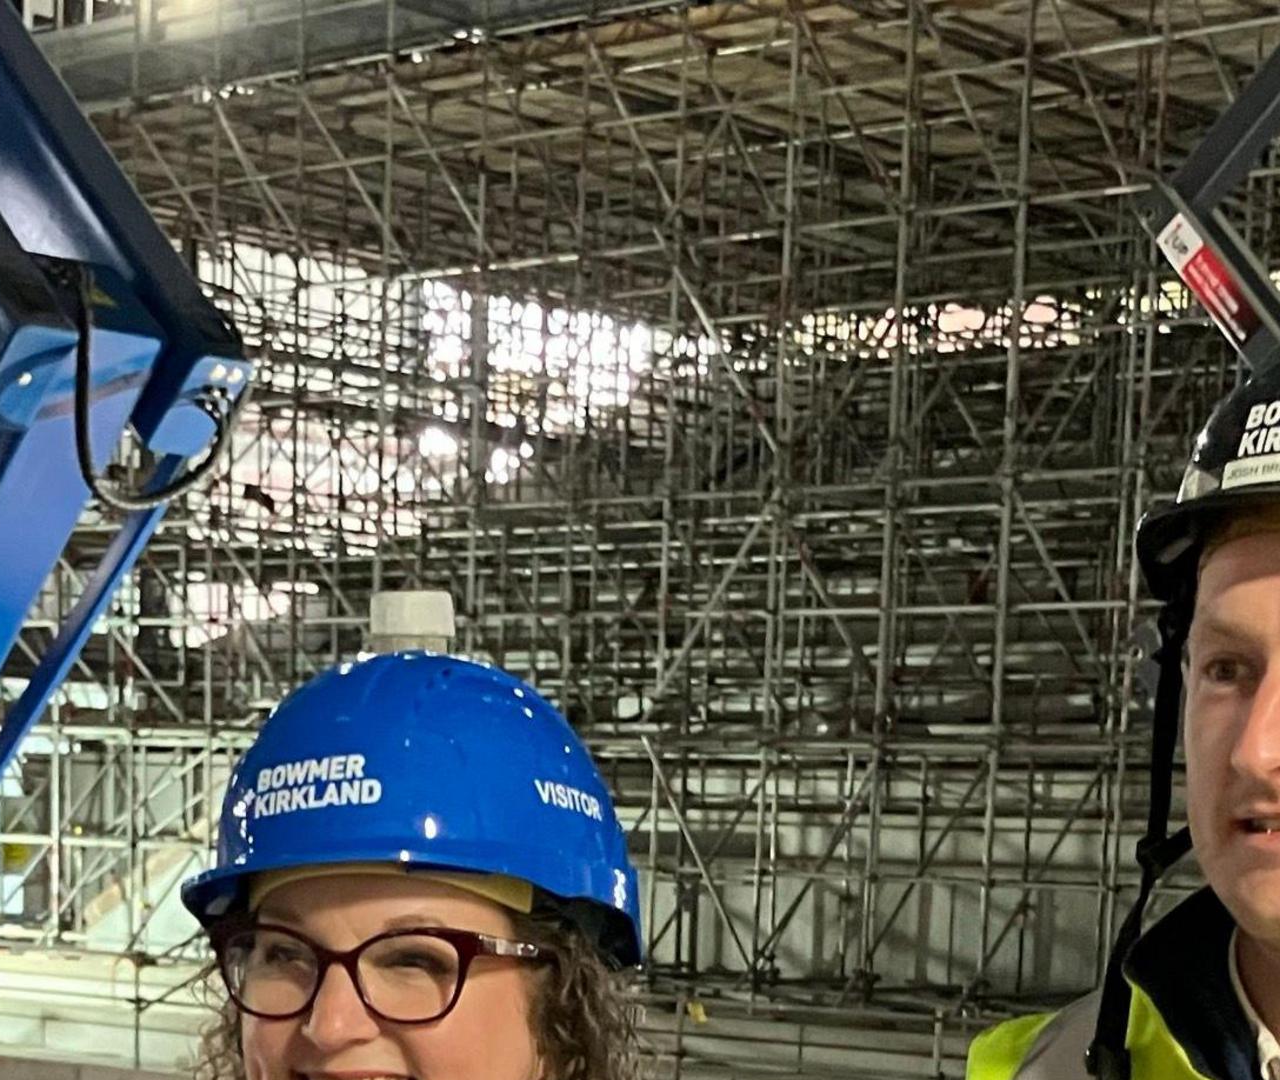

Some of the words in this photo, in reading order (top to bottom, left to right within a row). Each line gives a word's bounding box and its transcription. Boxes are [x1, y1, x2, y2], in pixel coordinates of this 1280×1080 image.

[256, 753, 366, 793] BOWMER
[254, 778, 382, 819] KIRKLAND
[533, 778, 602, 821] VISITOR
